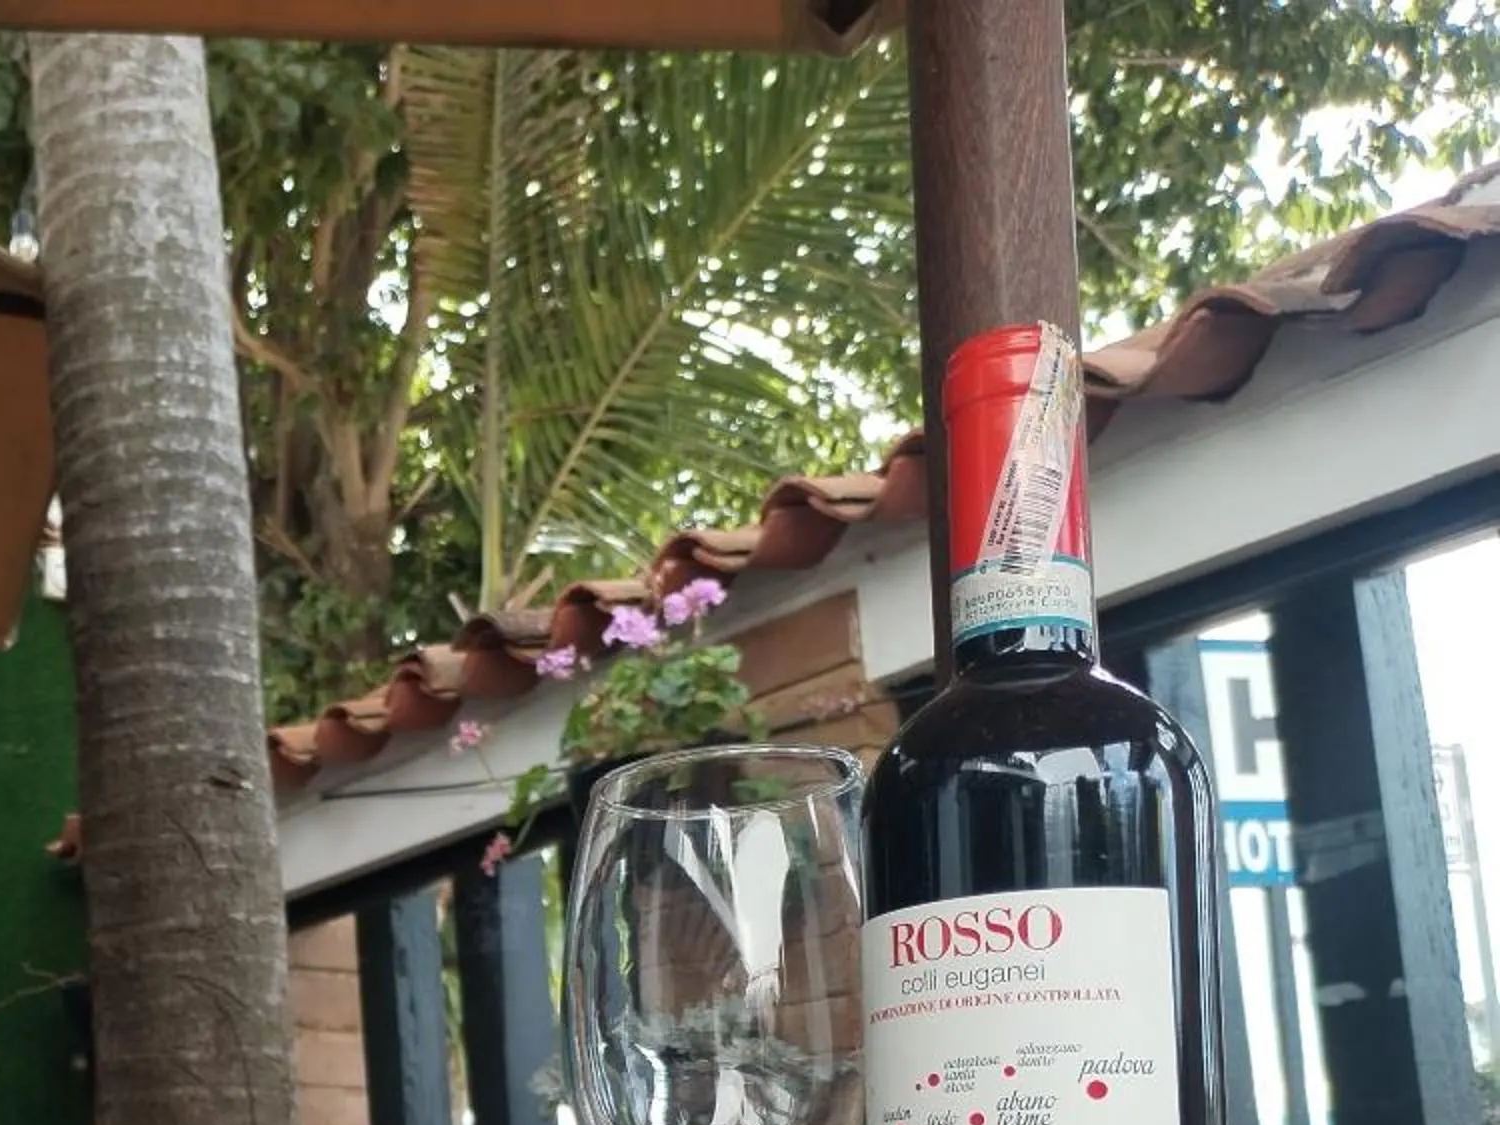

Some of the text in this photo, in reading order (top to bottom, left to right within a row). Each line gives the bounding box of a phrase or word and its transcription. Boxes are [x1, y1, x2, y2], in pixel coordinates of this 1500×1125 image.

[890, 904, 1063, 969] ROSSO
[901, 960, 1046, 996] colli euganei
[1078, 1051, 1156, 1085] padova
[996, 1090, 1058, 1112] abano
